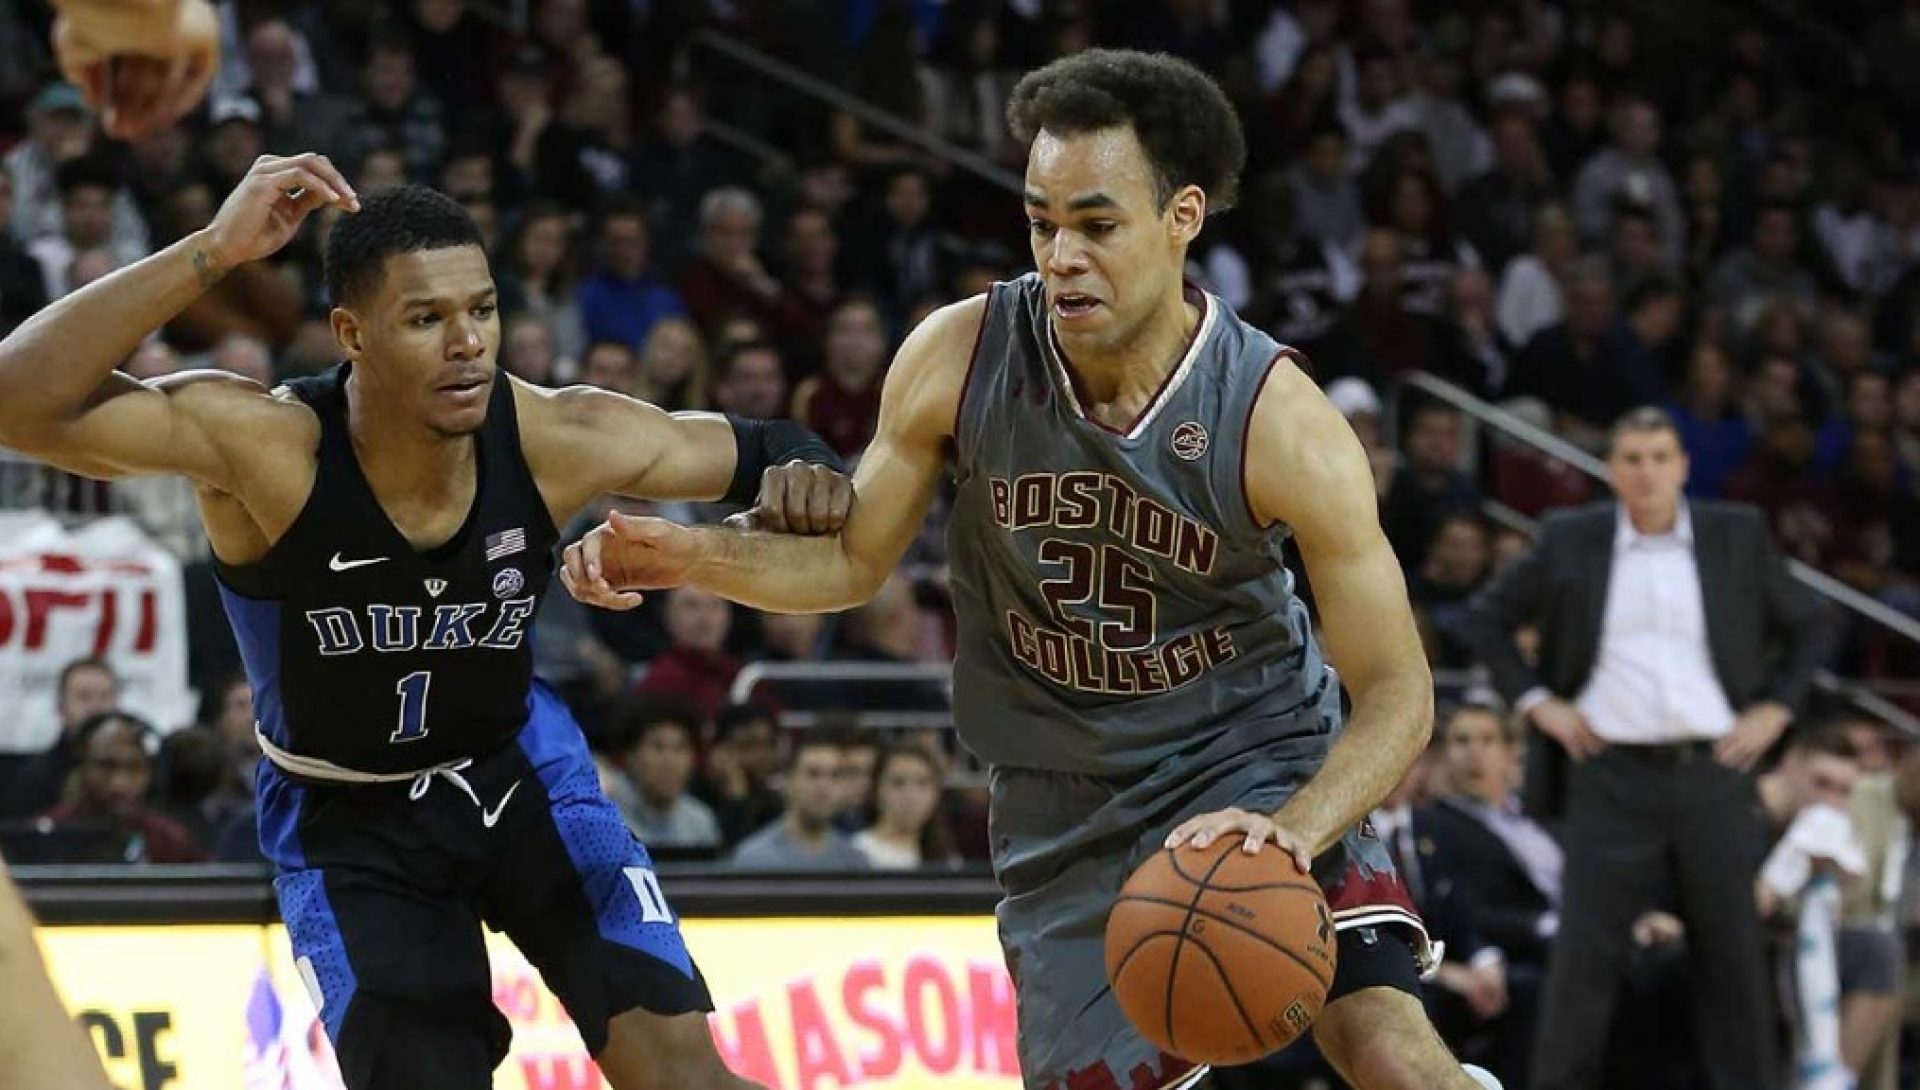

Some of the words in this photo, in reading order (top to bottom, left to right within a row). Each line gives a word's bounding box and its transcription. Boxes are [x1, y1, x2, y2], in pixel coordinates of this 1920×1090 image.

[989, 471, 1219, 575] BOSTON
[306, 595, 535, 656] DUKE
[1038, 537, 1156, 650] 25
[1007, 609, 1239, 693] COLLEGE
[389, 671, 432, 743] 1
